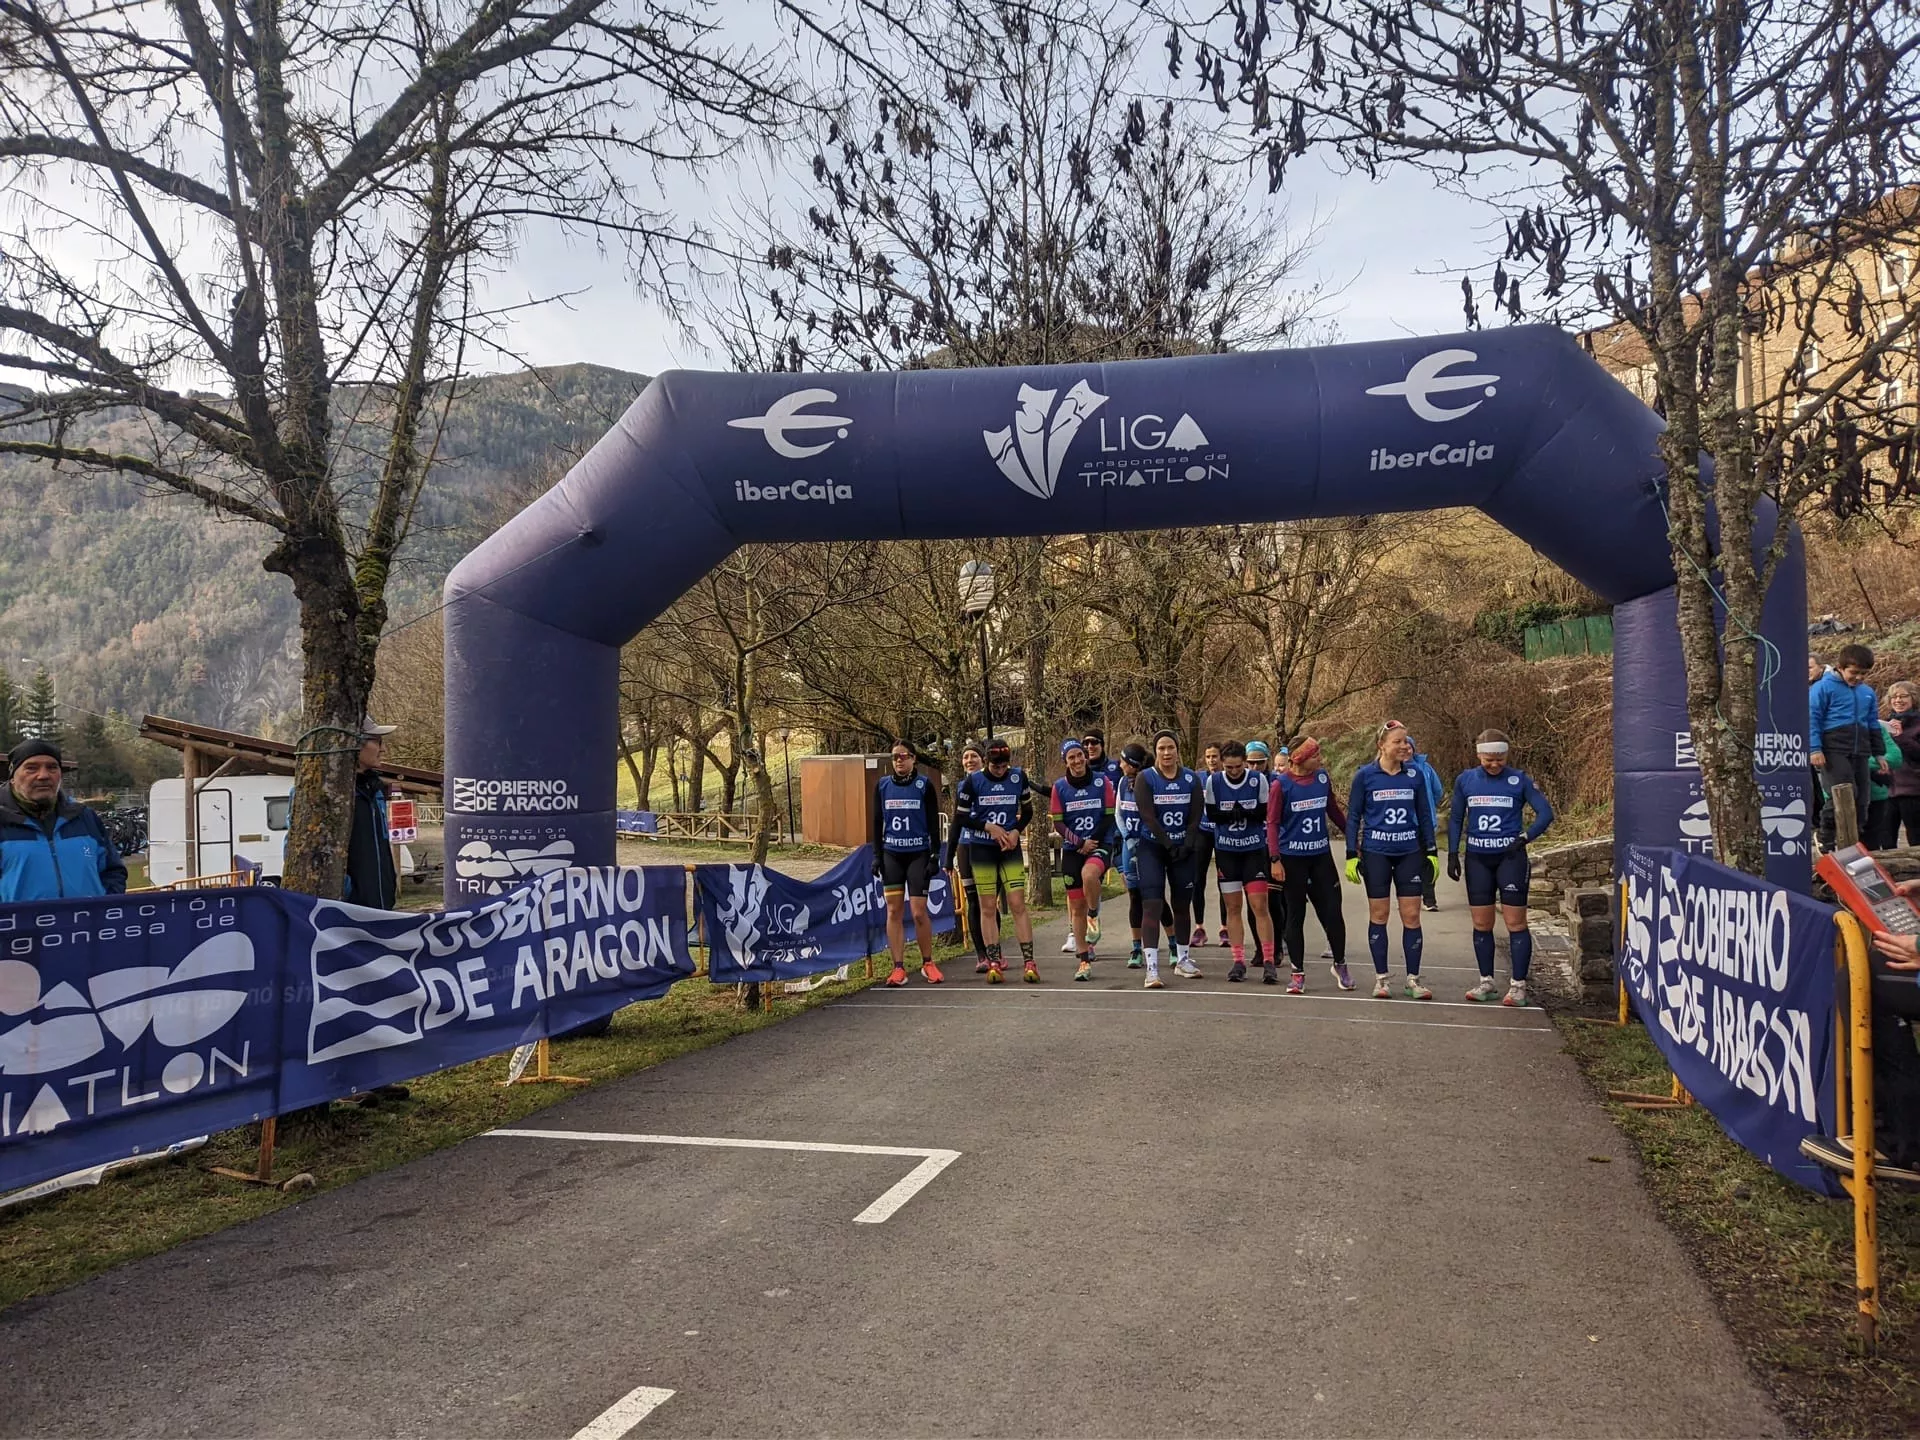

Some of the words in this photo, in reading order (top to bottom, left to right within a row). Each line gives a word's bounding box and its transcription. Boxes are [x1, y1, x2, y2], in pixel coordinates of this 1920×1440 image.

[1100, 412, 1210, 452] LIGA
[1083, 456, 1189, 468] aragonesa
[1204, 453, 1227, 461] de
[1369, 440, 1495, 472] iberCaja
[1078, 463, 1230, 488] TRIATLON
[734, 478, 853, 504] iberCaja
[476, 779, 567, 796] GOBIERNO
[476, 797, 497, 811] DE
[503, 795, 579, 811] ARAGON
[891, 815, 910, 831] 61
[986, 811, 1007, 825] 30
[1074, 816, 1095, 830] 28
[1126, 817, 1140, 831] 67
[1163, 811, 1184, 826] 63
[1228, 817, 1248, 831] 29
[1384, 807, 1407, 825] 32
[1478, 814, 1502, 831] 62
[460, 826, 566, 835] federación
[1301, 816, 1321, 834] 31
[885, 836, 923, 847] MAYENCOS
[1219, 834, 1260, 847] MAYENCOS
[1289, 836, 1329, 850] MAYENCOS
[1371, 830, 1417, 842] MAYENCOS
[1468, 836, 1516, 848] MAYENCOS
[423, 866, 645, 957] GOBIERNO
[765, 903, 811, 935] LIGA
[196, 914, 236, 929] de
[1681, 884, 1790, 992] GOBIERNO
[420, 955, 495, 1031] DE
[511, 915, 677, 1010] ARAGON
[1681, 972, 1708, 1056] DE
[1711, 985, 1816, 1123] ARAGON
